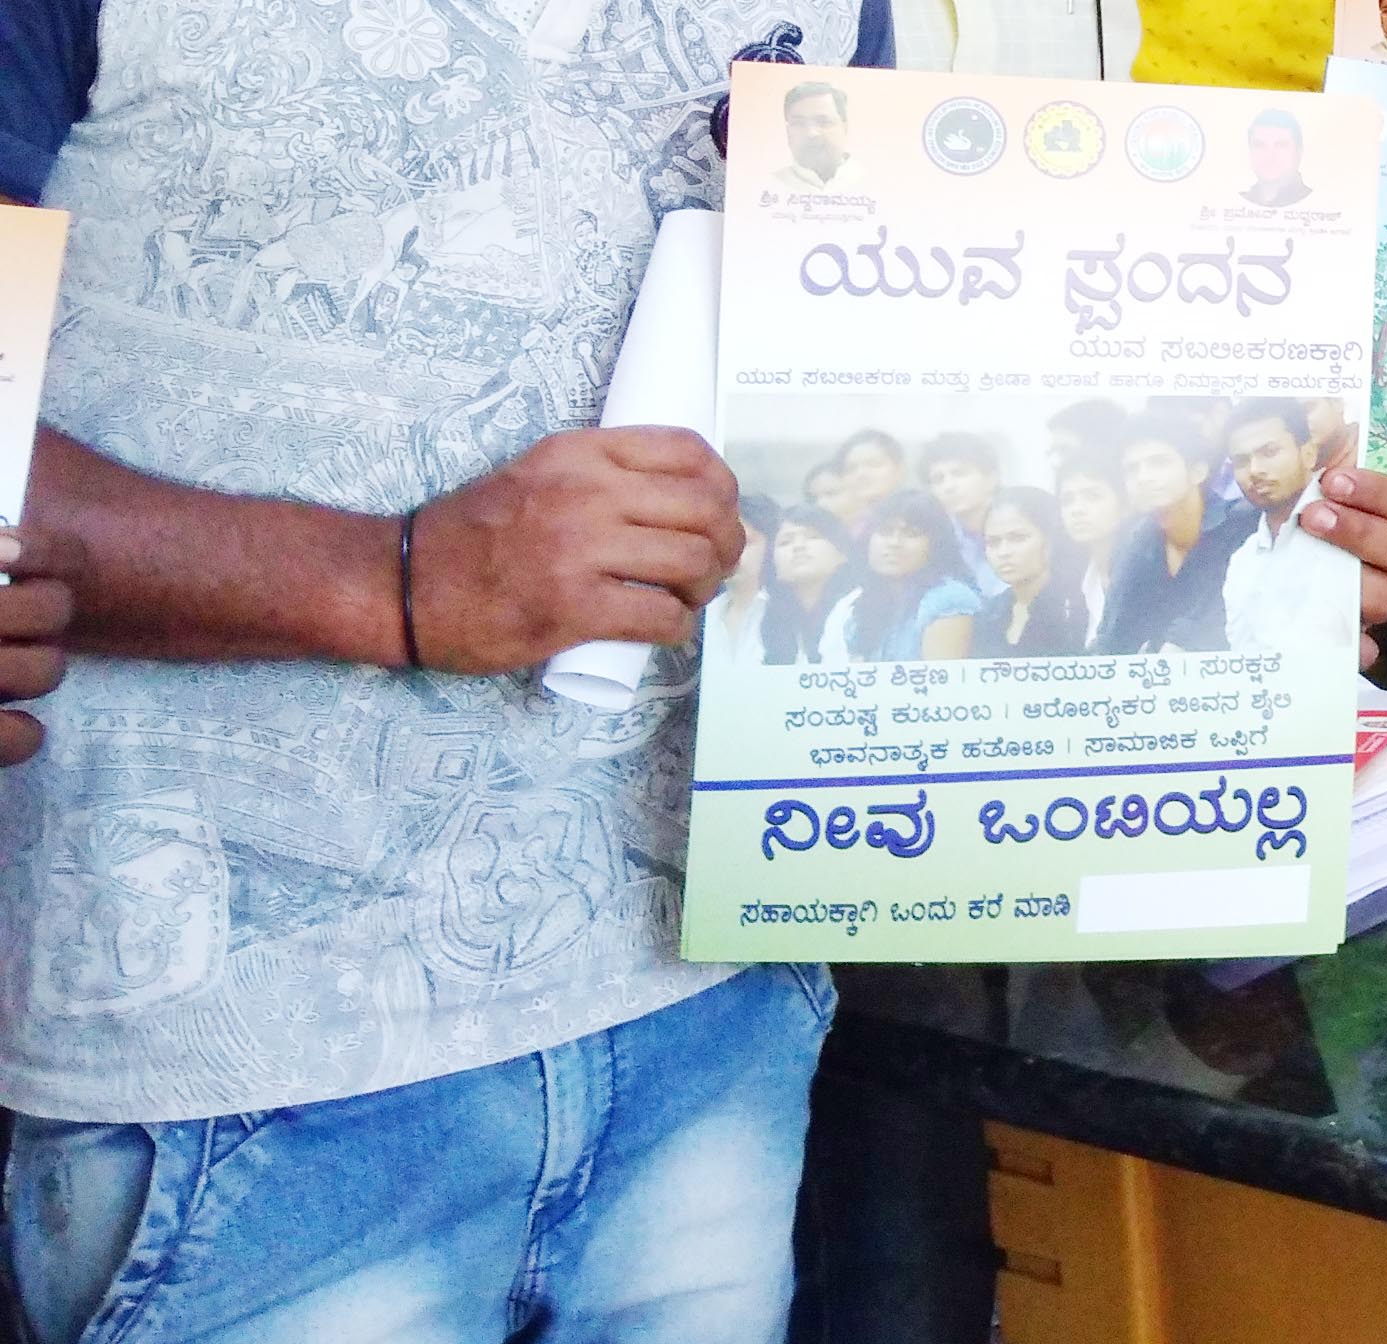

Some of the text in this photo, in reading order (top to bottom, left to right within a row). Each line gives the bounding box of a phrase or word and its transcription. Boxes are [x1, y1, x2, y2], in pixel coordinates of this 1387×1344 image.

[800, 225, 1294, 334] ಯುವ ಸ್ಪಂದನ
[762, 776, 1306, 861] ನೀವು ಒಂಟಿಯಲ್ಲ
